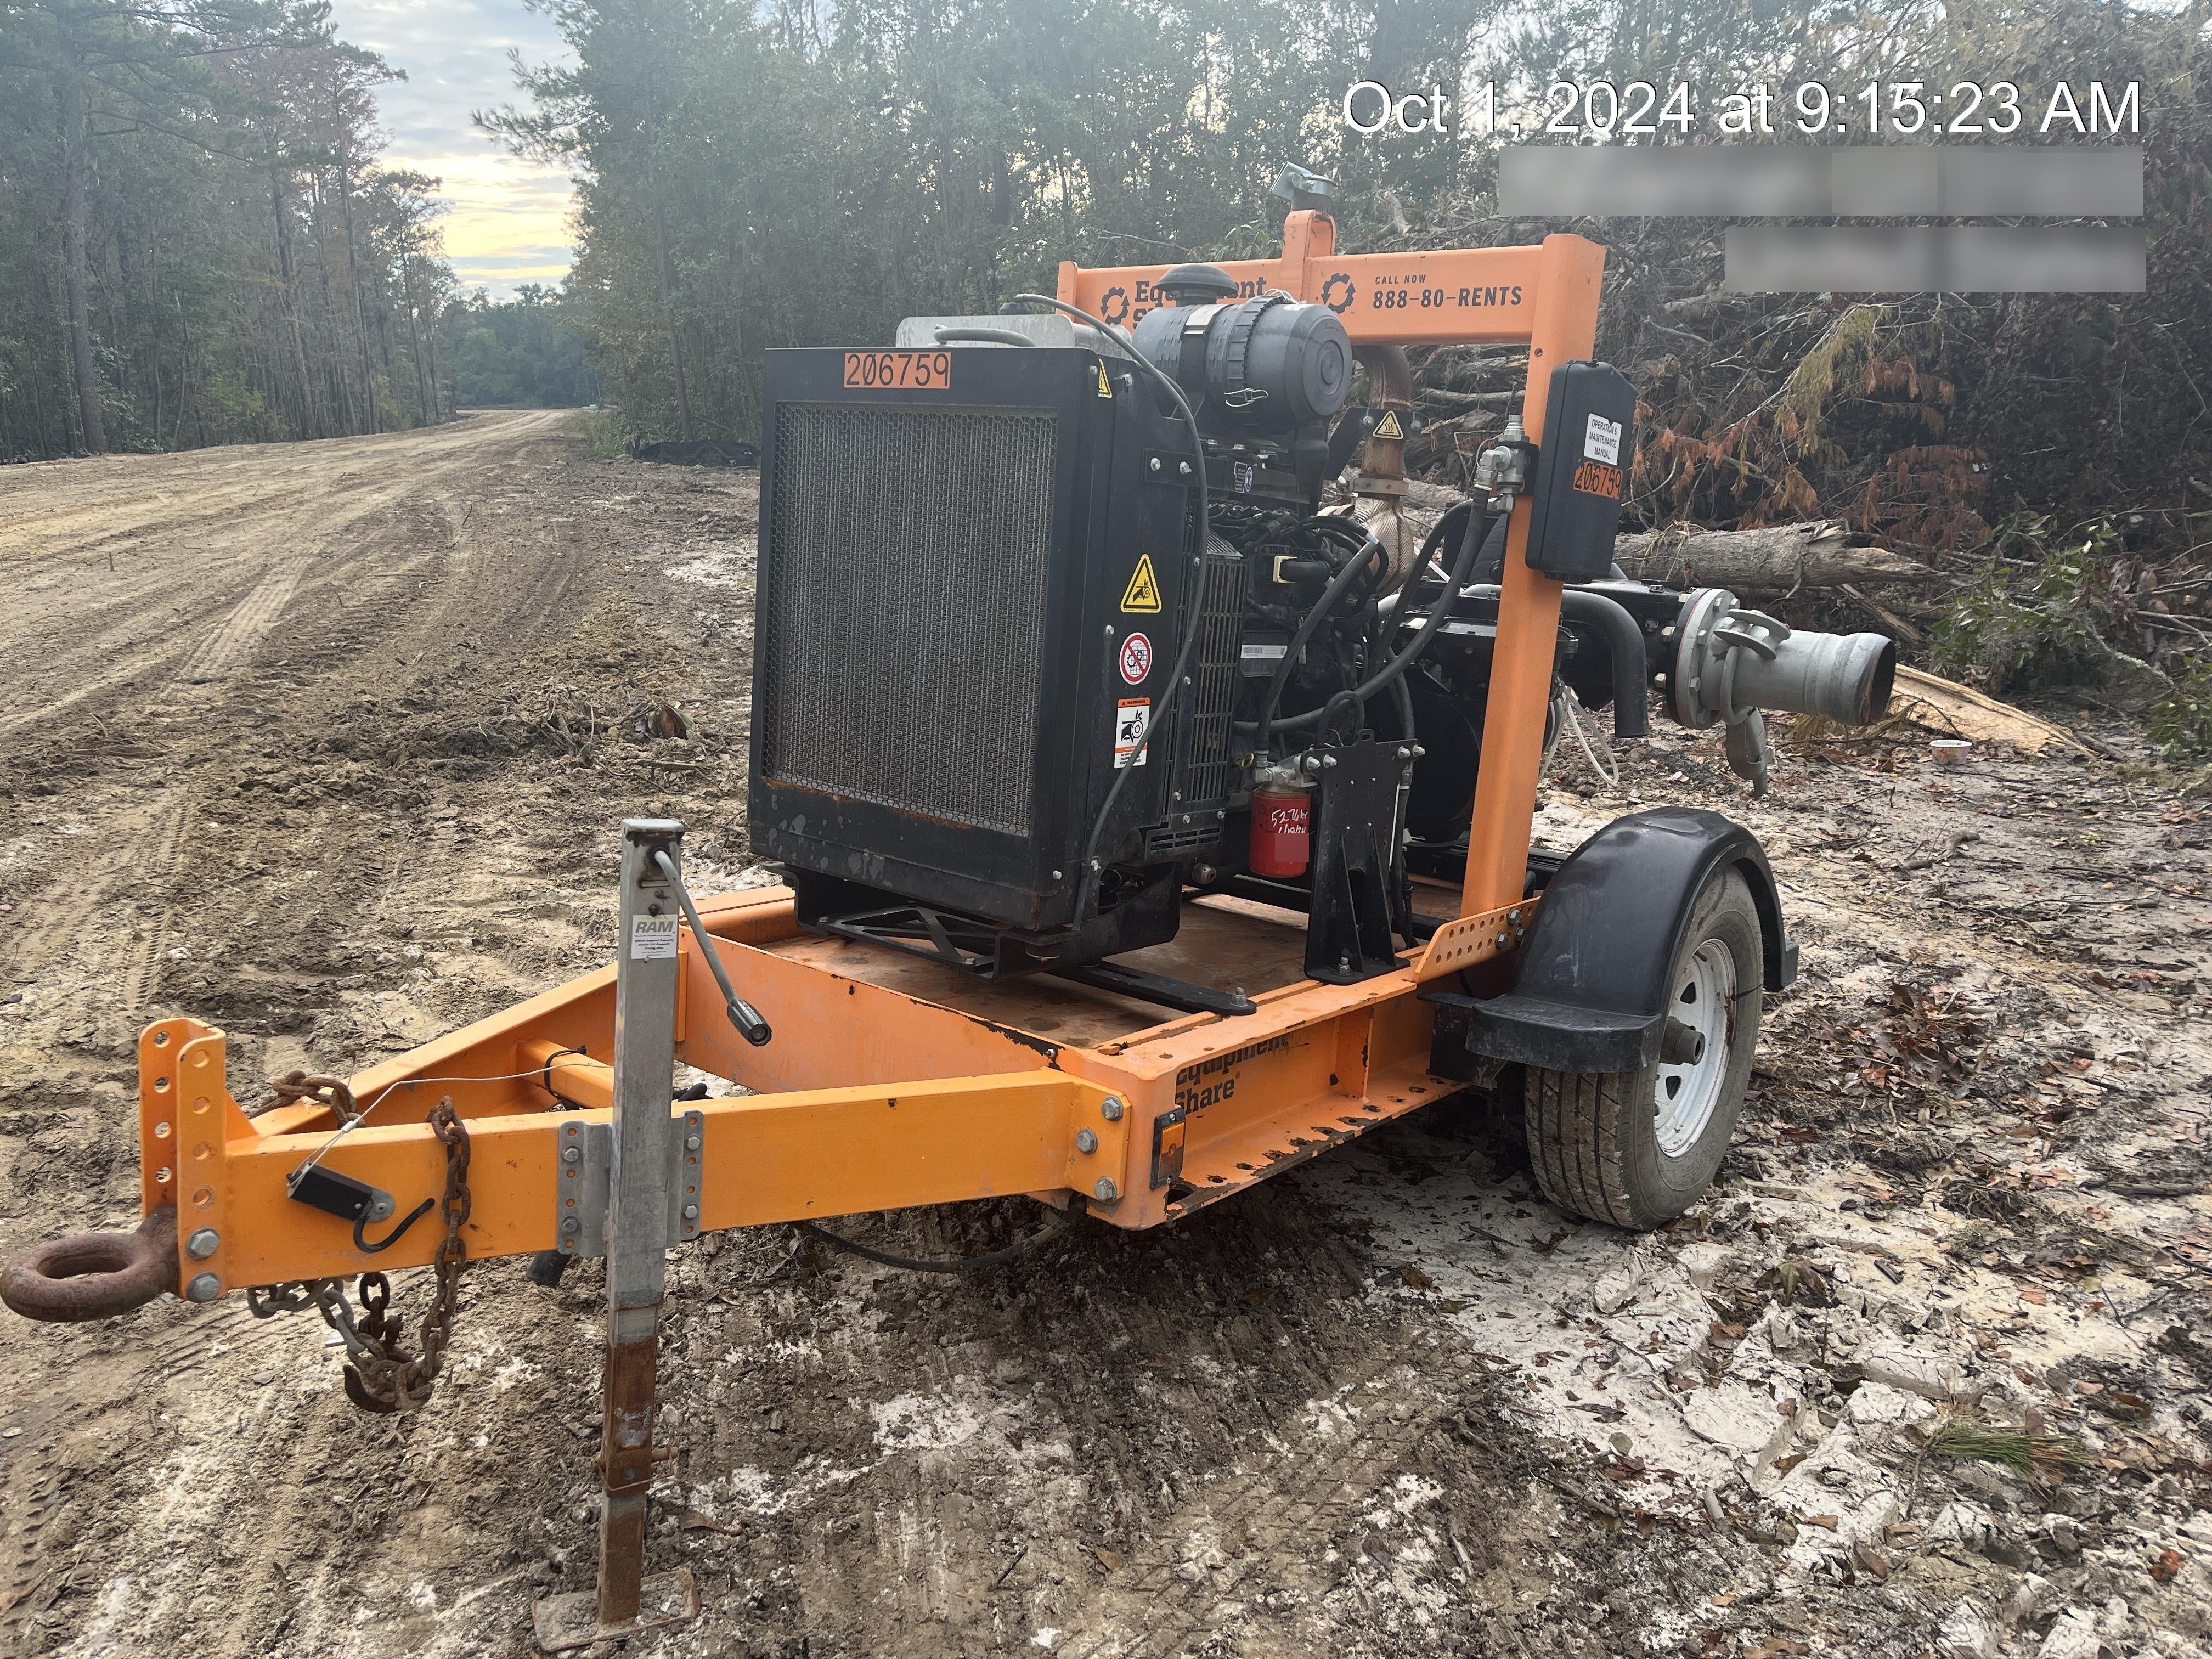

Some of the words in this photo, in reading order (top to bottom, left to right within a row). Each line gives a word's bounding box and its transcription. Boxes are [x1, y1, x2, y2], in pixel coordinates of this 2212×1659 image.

[1375, 275, 1399, 285] CALL
[1404, 274, 1426, 284] NOW
[1373, 285, 1522, 309] 888-80-RENTS
[846, 353, 949, 386] 206759
[1592, 419, 1614, 435] OPERATION
[1614, 427, 1617, 435] &
[1589, 431, 1617, 448] MAINTENANCE
[1594, 446, 1611, 459] MANUAL
[1574, 463, 1622, 499] 206759
[636, 921, 674, 933] RAM
